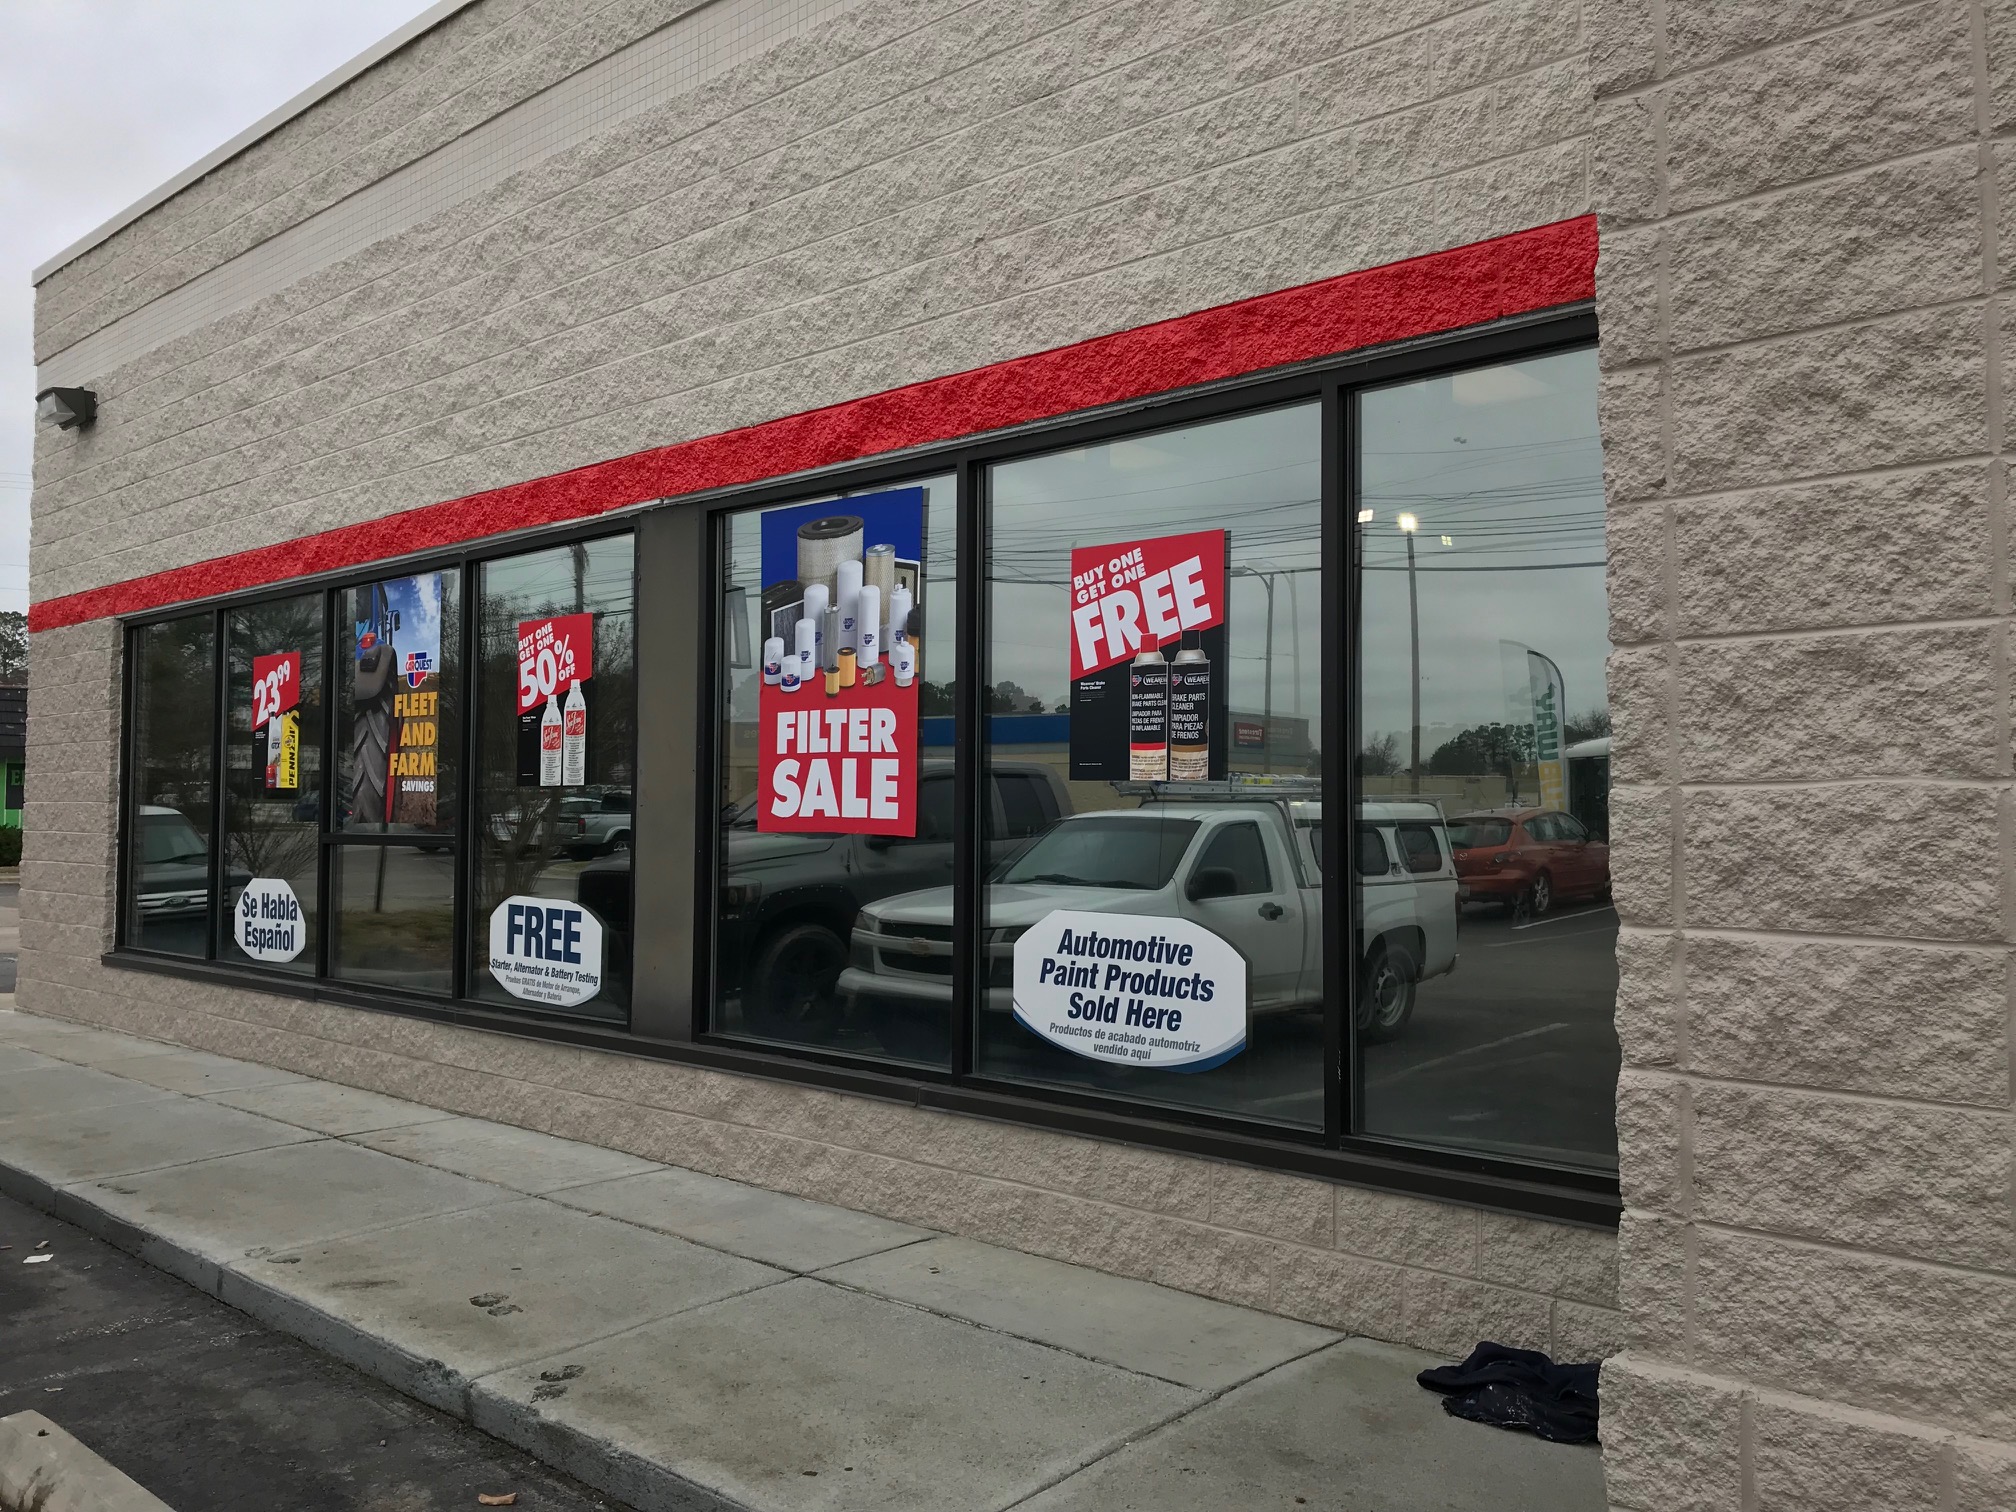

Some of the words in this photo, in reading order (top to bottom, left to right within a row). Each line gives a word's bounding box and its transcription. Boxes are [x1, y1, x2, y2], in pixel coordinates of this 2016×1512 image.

[1073, 564, 1104, 590] BUY
[1108, 547, 1143, 573] ONE
[1077, 580, 1106, 604] GET
[1111, 563, 1146, 588] ONE
[1072, 555, 1212, 671] FREE
[518, 633, 534, 651] BUY
[535, 622, 553, 639] ONE
[519, 645, 534, 661] GET
[537, 633, 554, 650] ONE
[520, 634, 574, 707] 50%
[558, 663, 575, 681] OFF
[394, 691, 437, 718] FLEET
[1188, 692, 1206, 701] PARTS
[400, 722, 436, 747] AND
[776, 708, 898, 754] FILTER
[1177, 730, 1199, 739] FRENOS
[1184, 721, 1204, 730] PIEZAS
[288, 725, 296, 786] PENNZI
[389, 753, 435, 777] FARM
[401, 780, 435, 793] SAVINGS
[770, 758, 899, 819] SALE
[242, 891, 257, 918] Se
[261, 893, 298, 921] Habla
[245, 921, 294, 954] Español
[507, 904, 582, 965] FREE
[1057, 928, 1193, 966] Automotive
[491, 958, 513, 973] Starter,
[514, 962, 543, 976] Alternator
[544, 966, 550, 977] &
[551, 968, 574, 982] Battery
[575, 971, 599, 986] Testing
[542, 981, 555, 990] Motor
[555, 982, 560, 991] de
[1039, 957, 1100, 989] Paint
[1104, 964, 1215, 1002] Products
[1067, 992, 1120, 1024] Sold
[1125, 999, 1182, 1032] Here
[1050, 1022, 1093, 1039] Productos
[1094, 1029, 1106, 1040] de
[1107, 1030, 1147, 1046] acabado
[1149, 1036, 1201, 1053] automotriz
[1093, 1042, 1129, 1057] vendido
[1130, 1048, 1152, 1062] aquí
